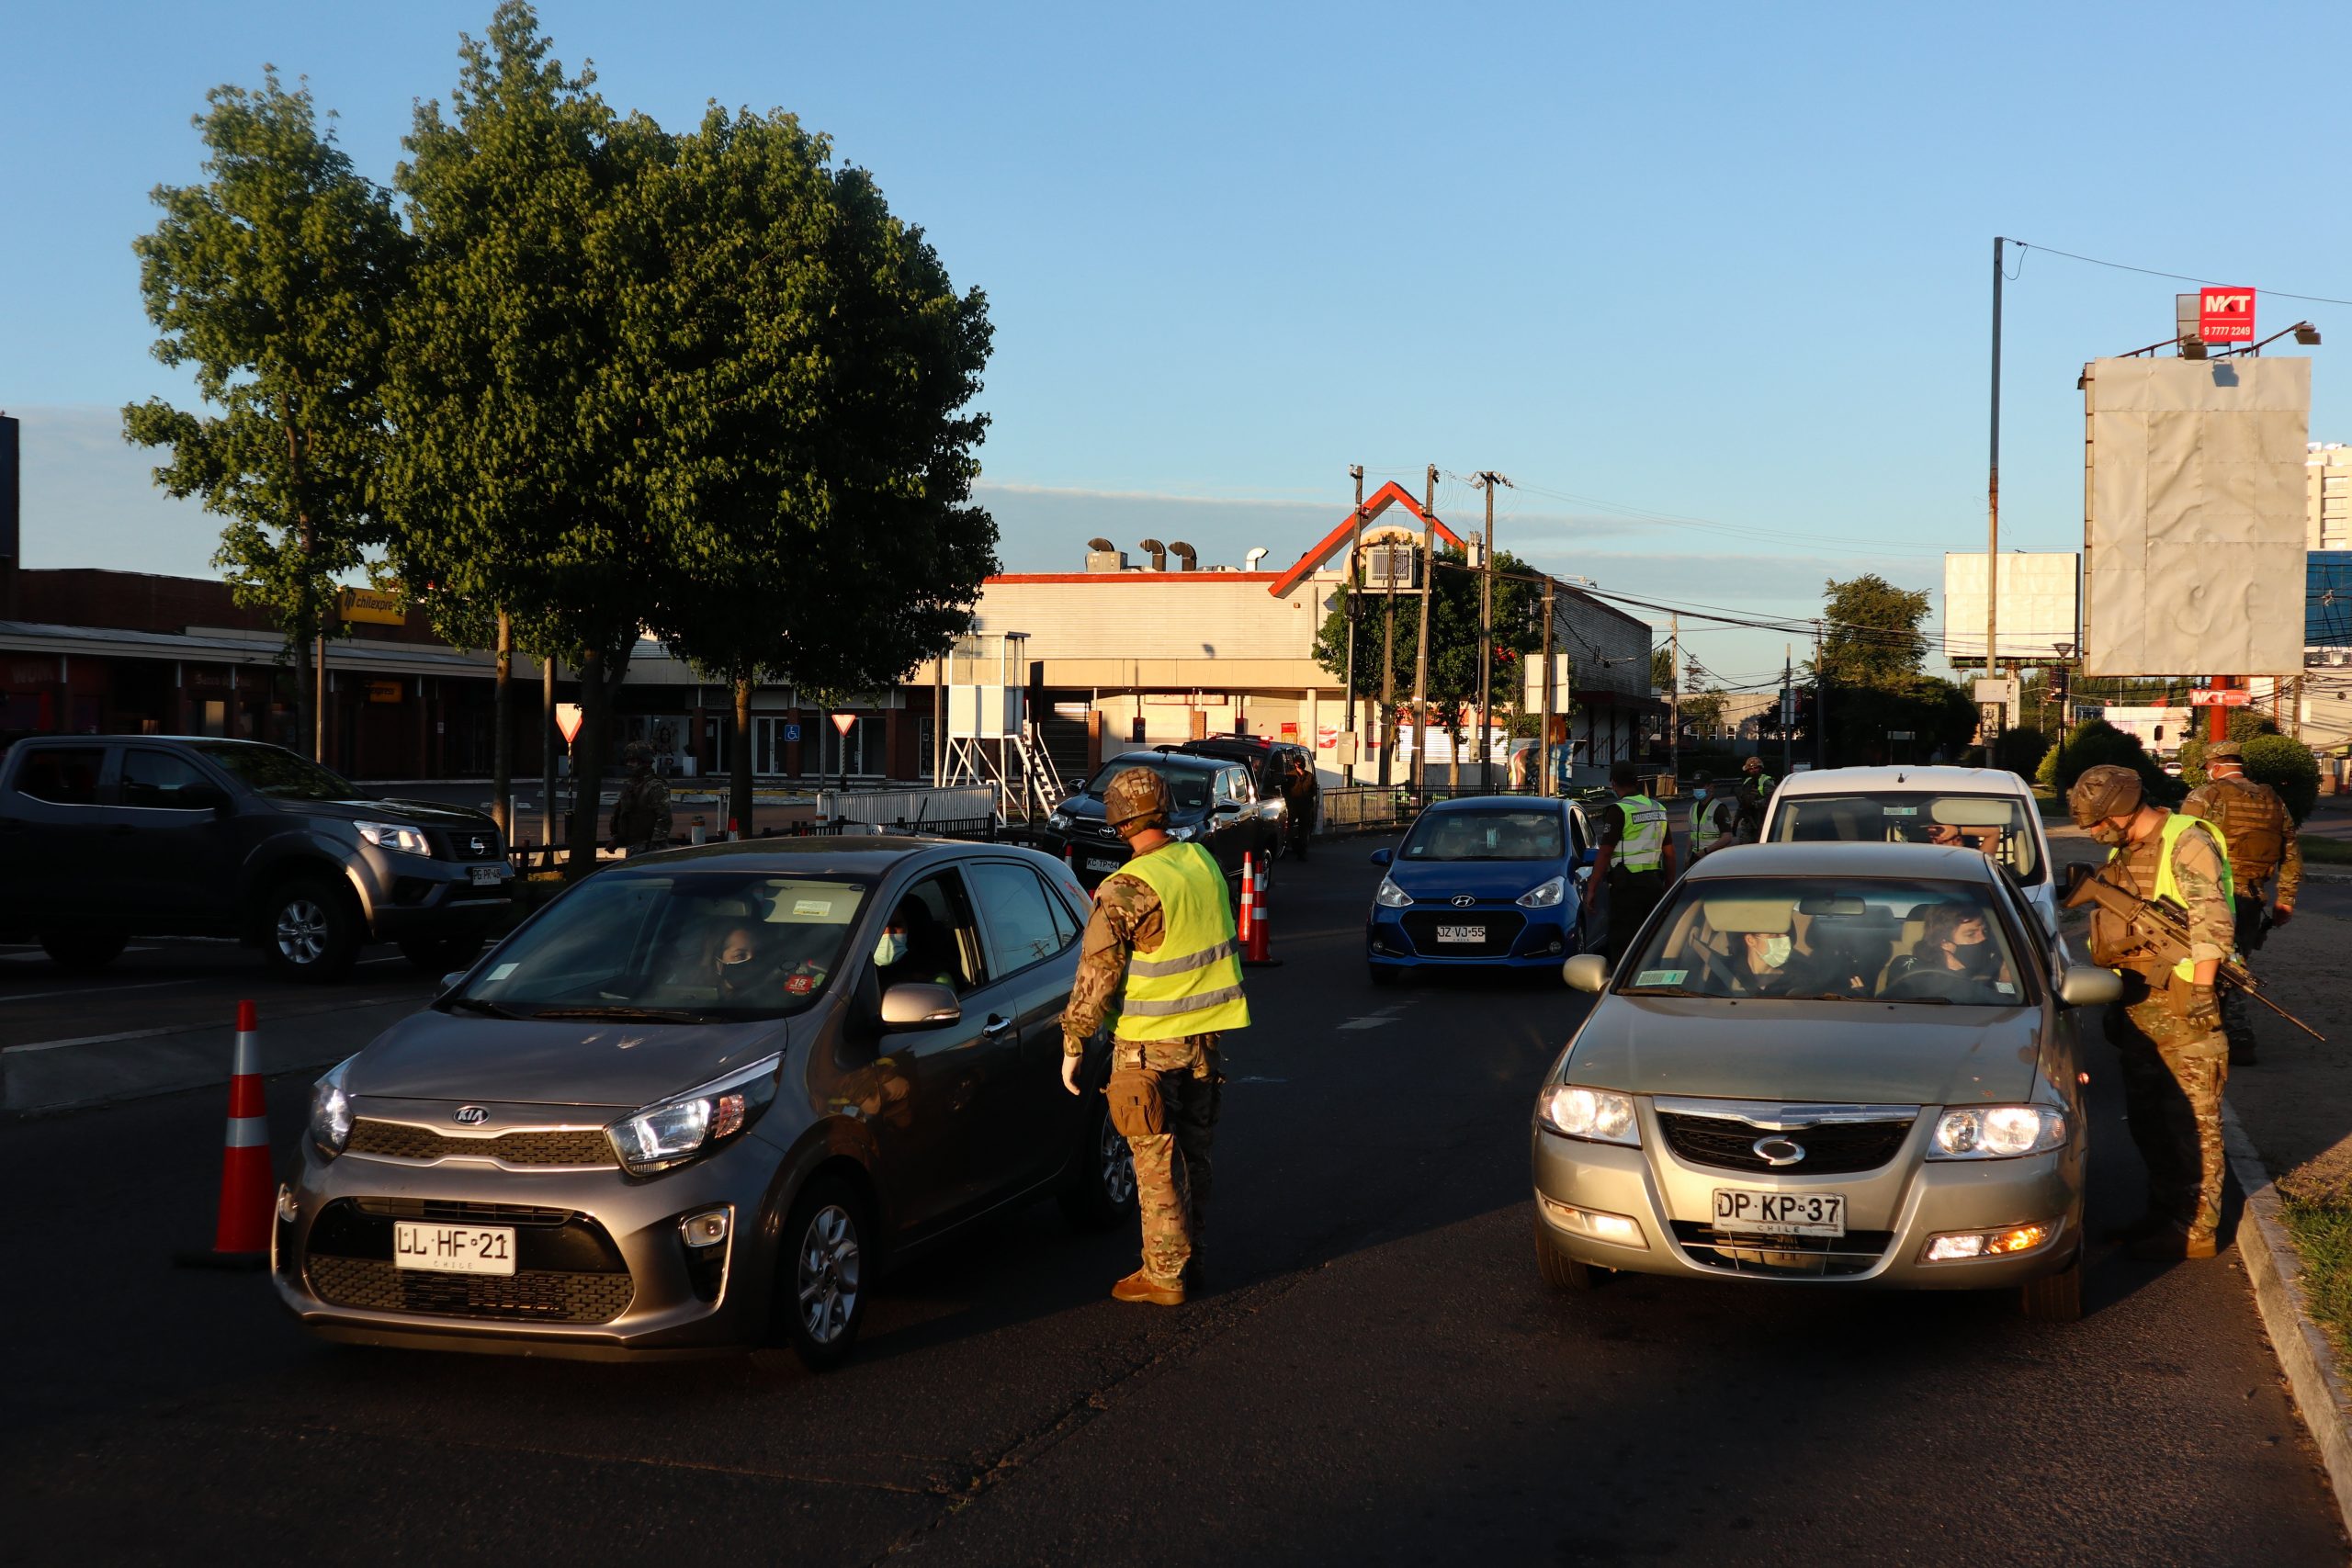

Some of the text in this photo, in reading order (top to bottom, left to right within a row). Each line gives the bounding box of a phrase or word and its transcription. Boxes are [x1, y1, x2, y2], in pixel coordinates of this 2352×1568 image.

[2205, 296, 2251, 312] MKT
[2205, 326, 2251, 336] 9 7777 2249
[356, 593, 393, 613] chilexpre
[2192, 691, 2226, 704] MKT
[458, 1109, 483, 1121] KIA
[1757, 1224, 1801, 1234] CHILE
